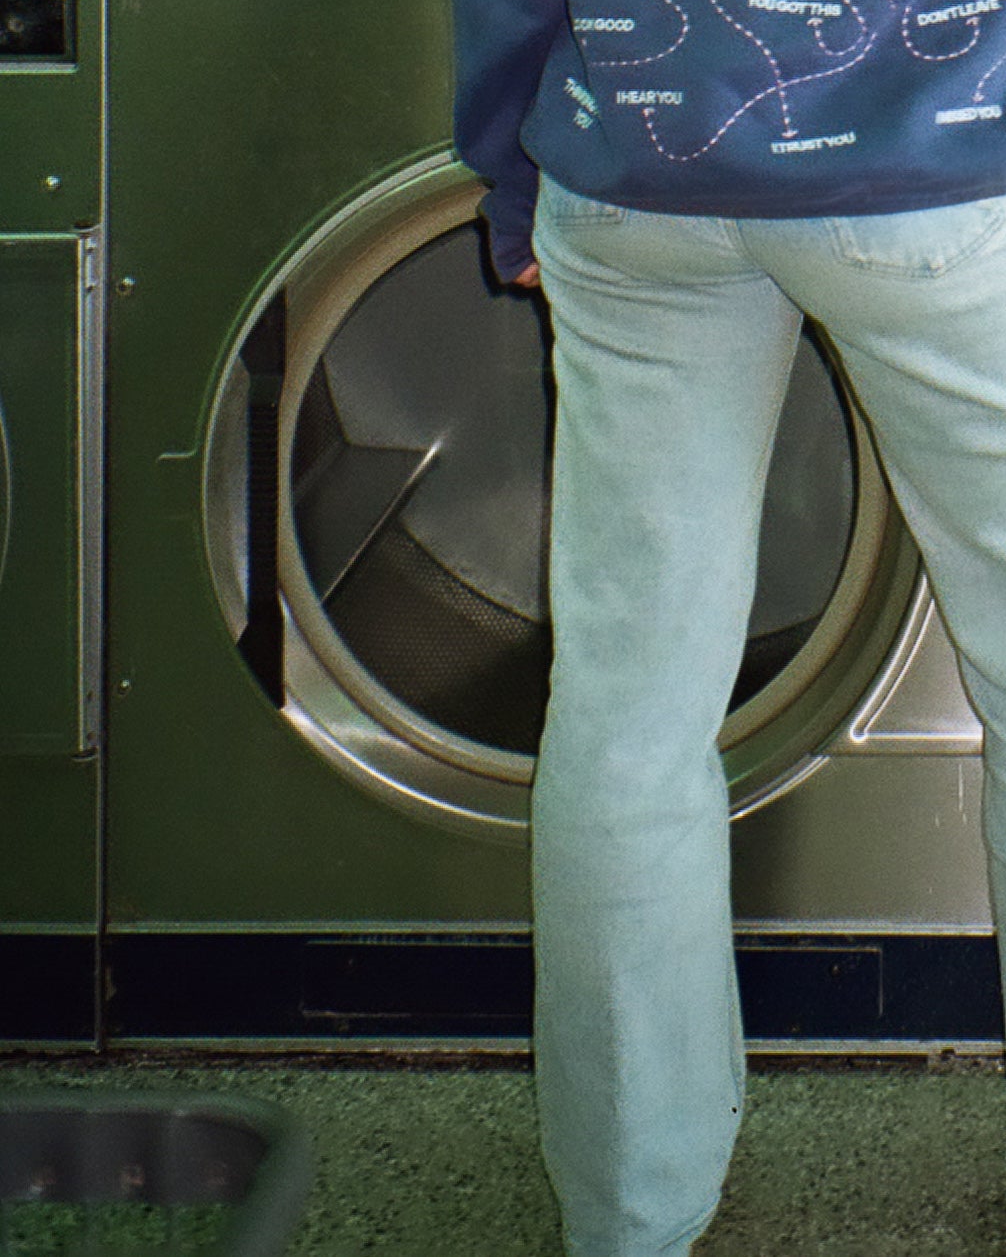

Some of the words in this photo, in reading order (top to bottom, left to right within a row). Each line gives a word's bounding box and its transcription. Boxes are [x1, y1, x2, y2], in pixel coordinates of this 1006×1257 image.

[777, 0, 807, 14] GOT
[806, 2, 842, 17] THIS
[594, 18, 635, 32] GOOD
[621, 91, 656, 104] HEAR
[656, 91, 683, 105] YOU
[978, 104, 1002, 120] YOU
[775, 139, 823, 154] TRUST
[823, 131, 857, 148] YOU
